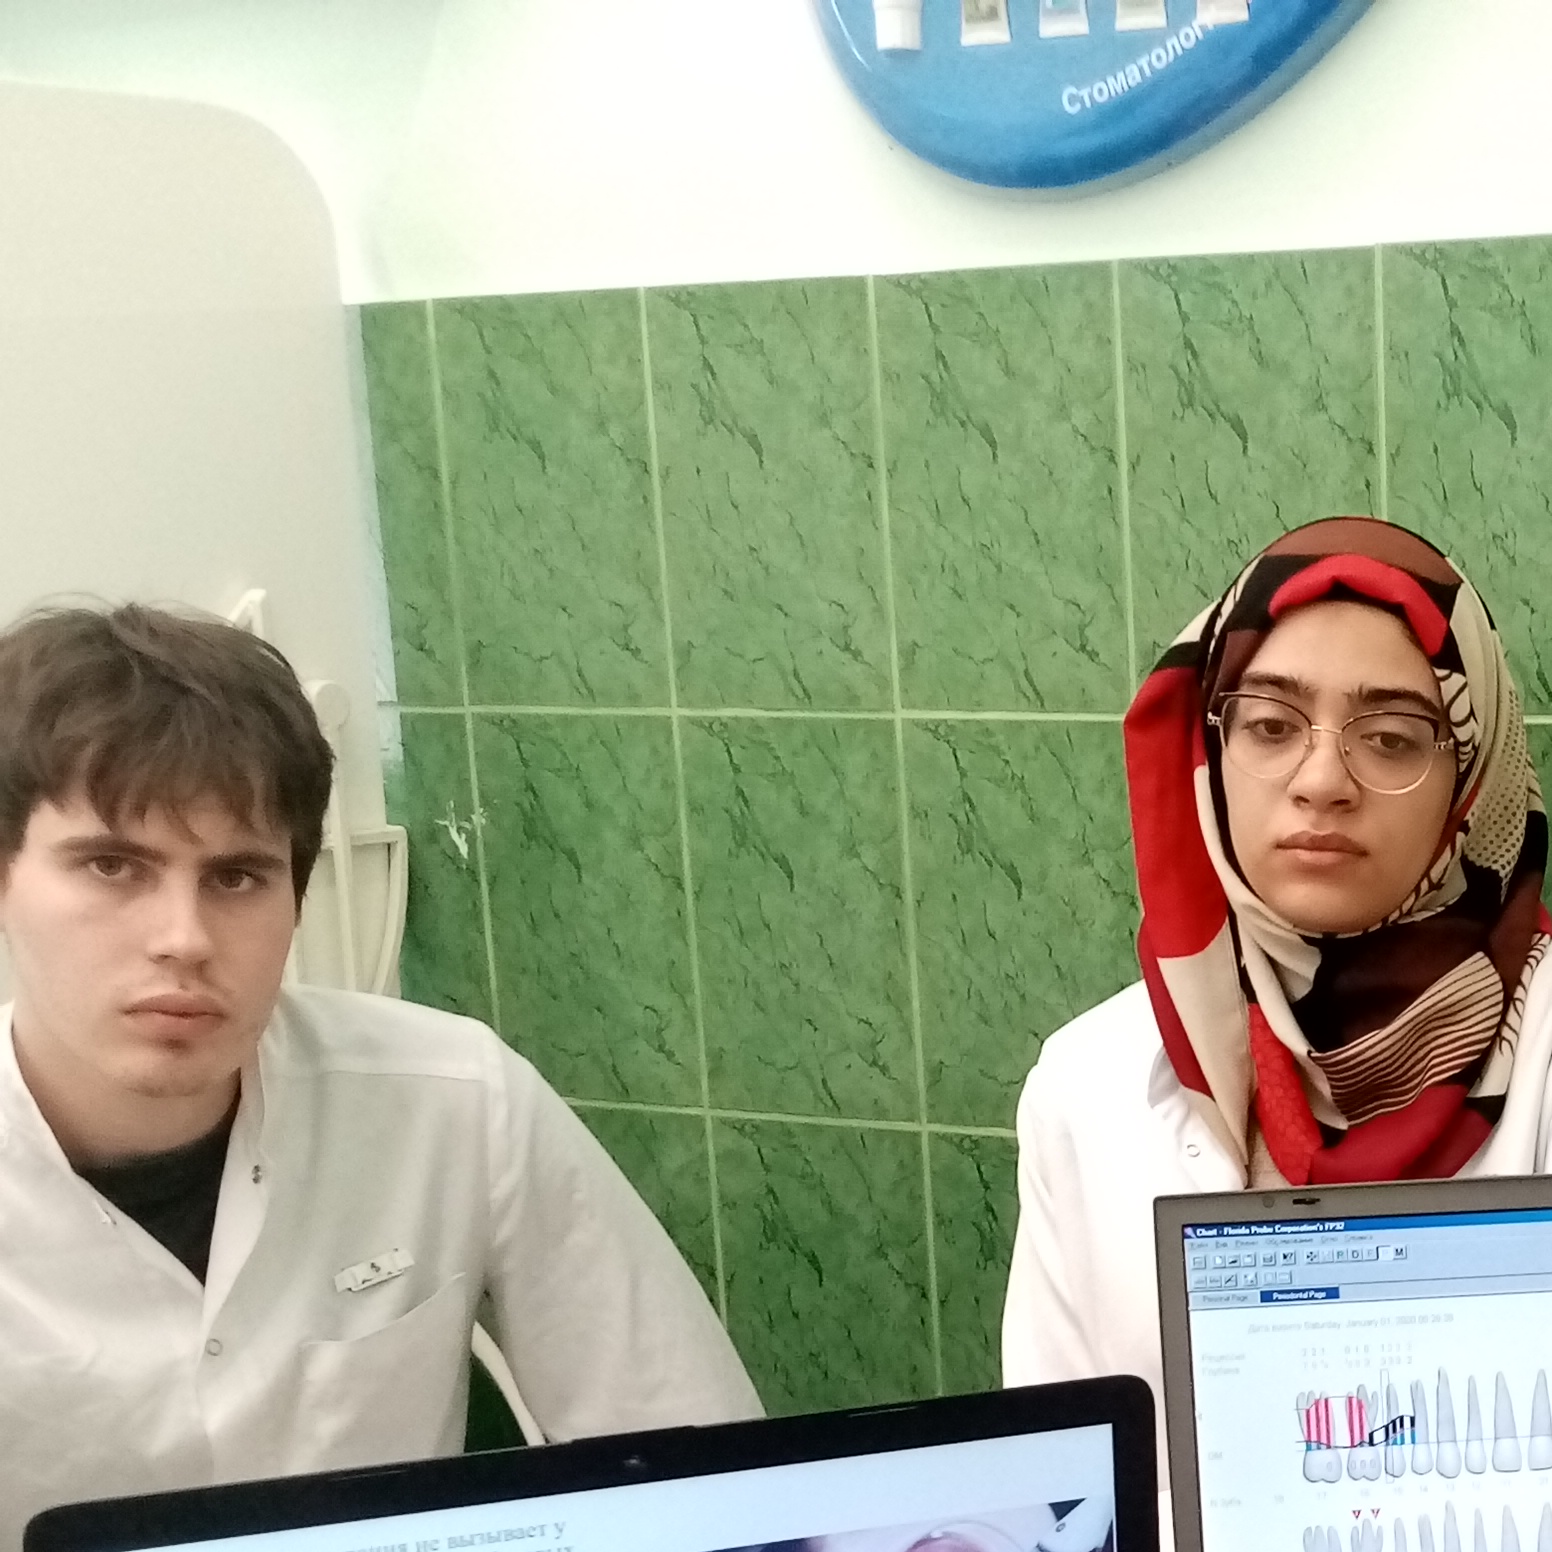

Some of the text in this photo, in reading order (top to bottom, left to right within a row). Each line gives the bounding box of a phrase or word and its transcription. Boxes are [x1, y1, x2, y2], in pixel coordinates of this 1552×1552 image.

[1061, 9, 1217, 115] Стоматолог
[1224, 1225, 1249, 1236] Florida
[447, 1524, 547, 1549] вызывает
